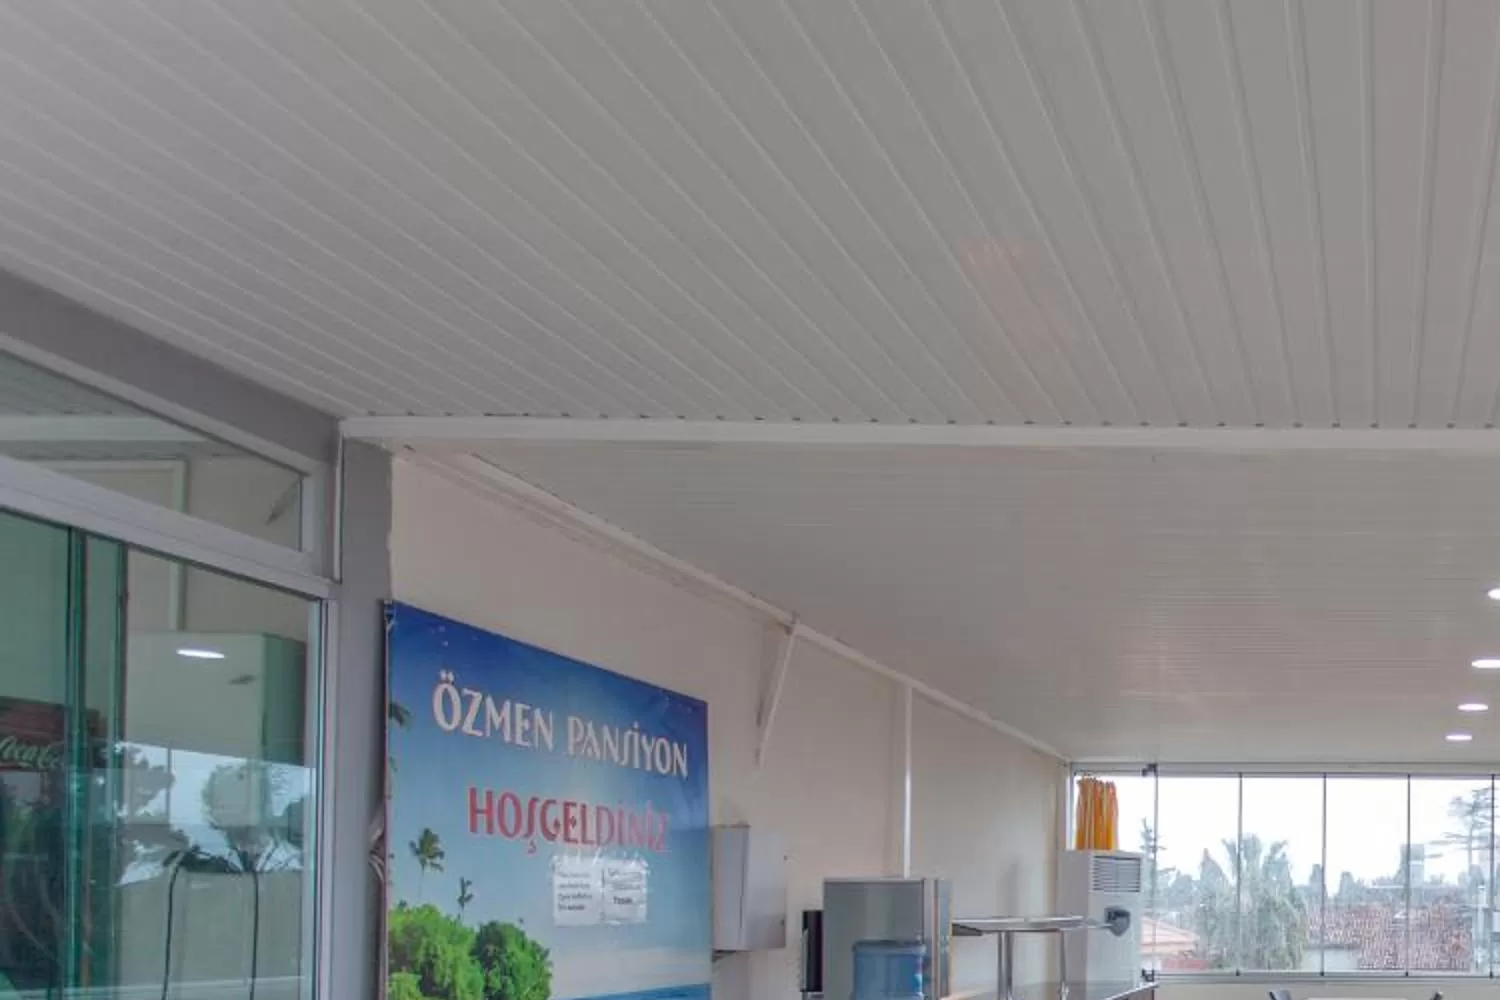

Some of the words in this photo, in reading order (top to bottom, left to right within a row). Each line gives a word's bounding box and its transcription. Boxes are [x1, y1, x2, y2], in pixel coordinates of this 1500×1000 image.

[432, 669, 555, 752] ÖZMEN
[566, 716, 689, 780] PANSİYON
[467, 786, 669, 855] HOŞGELDİNİZ
